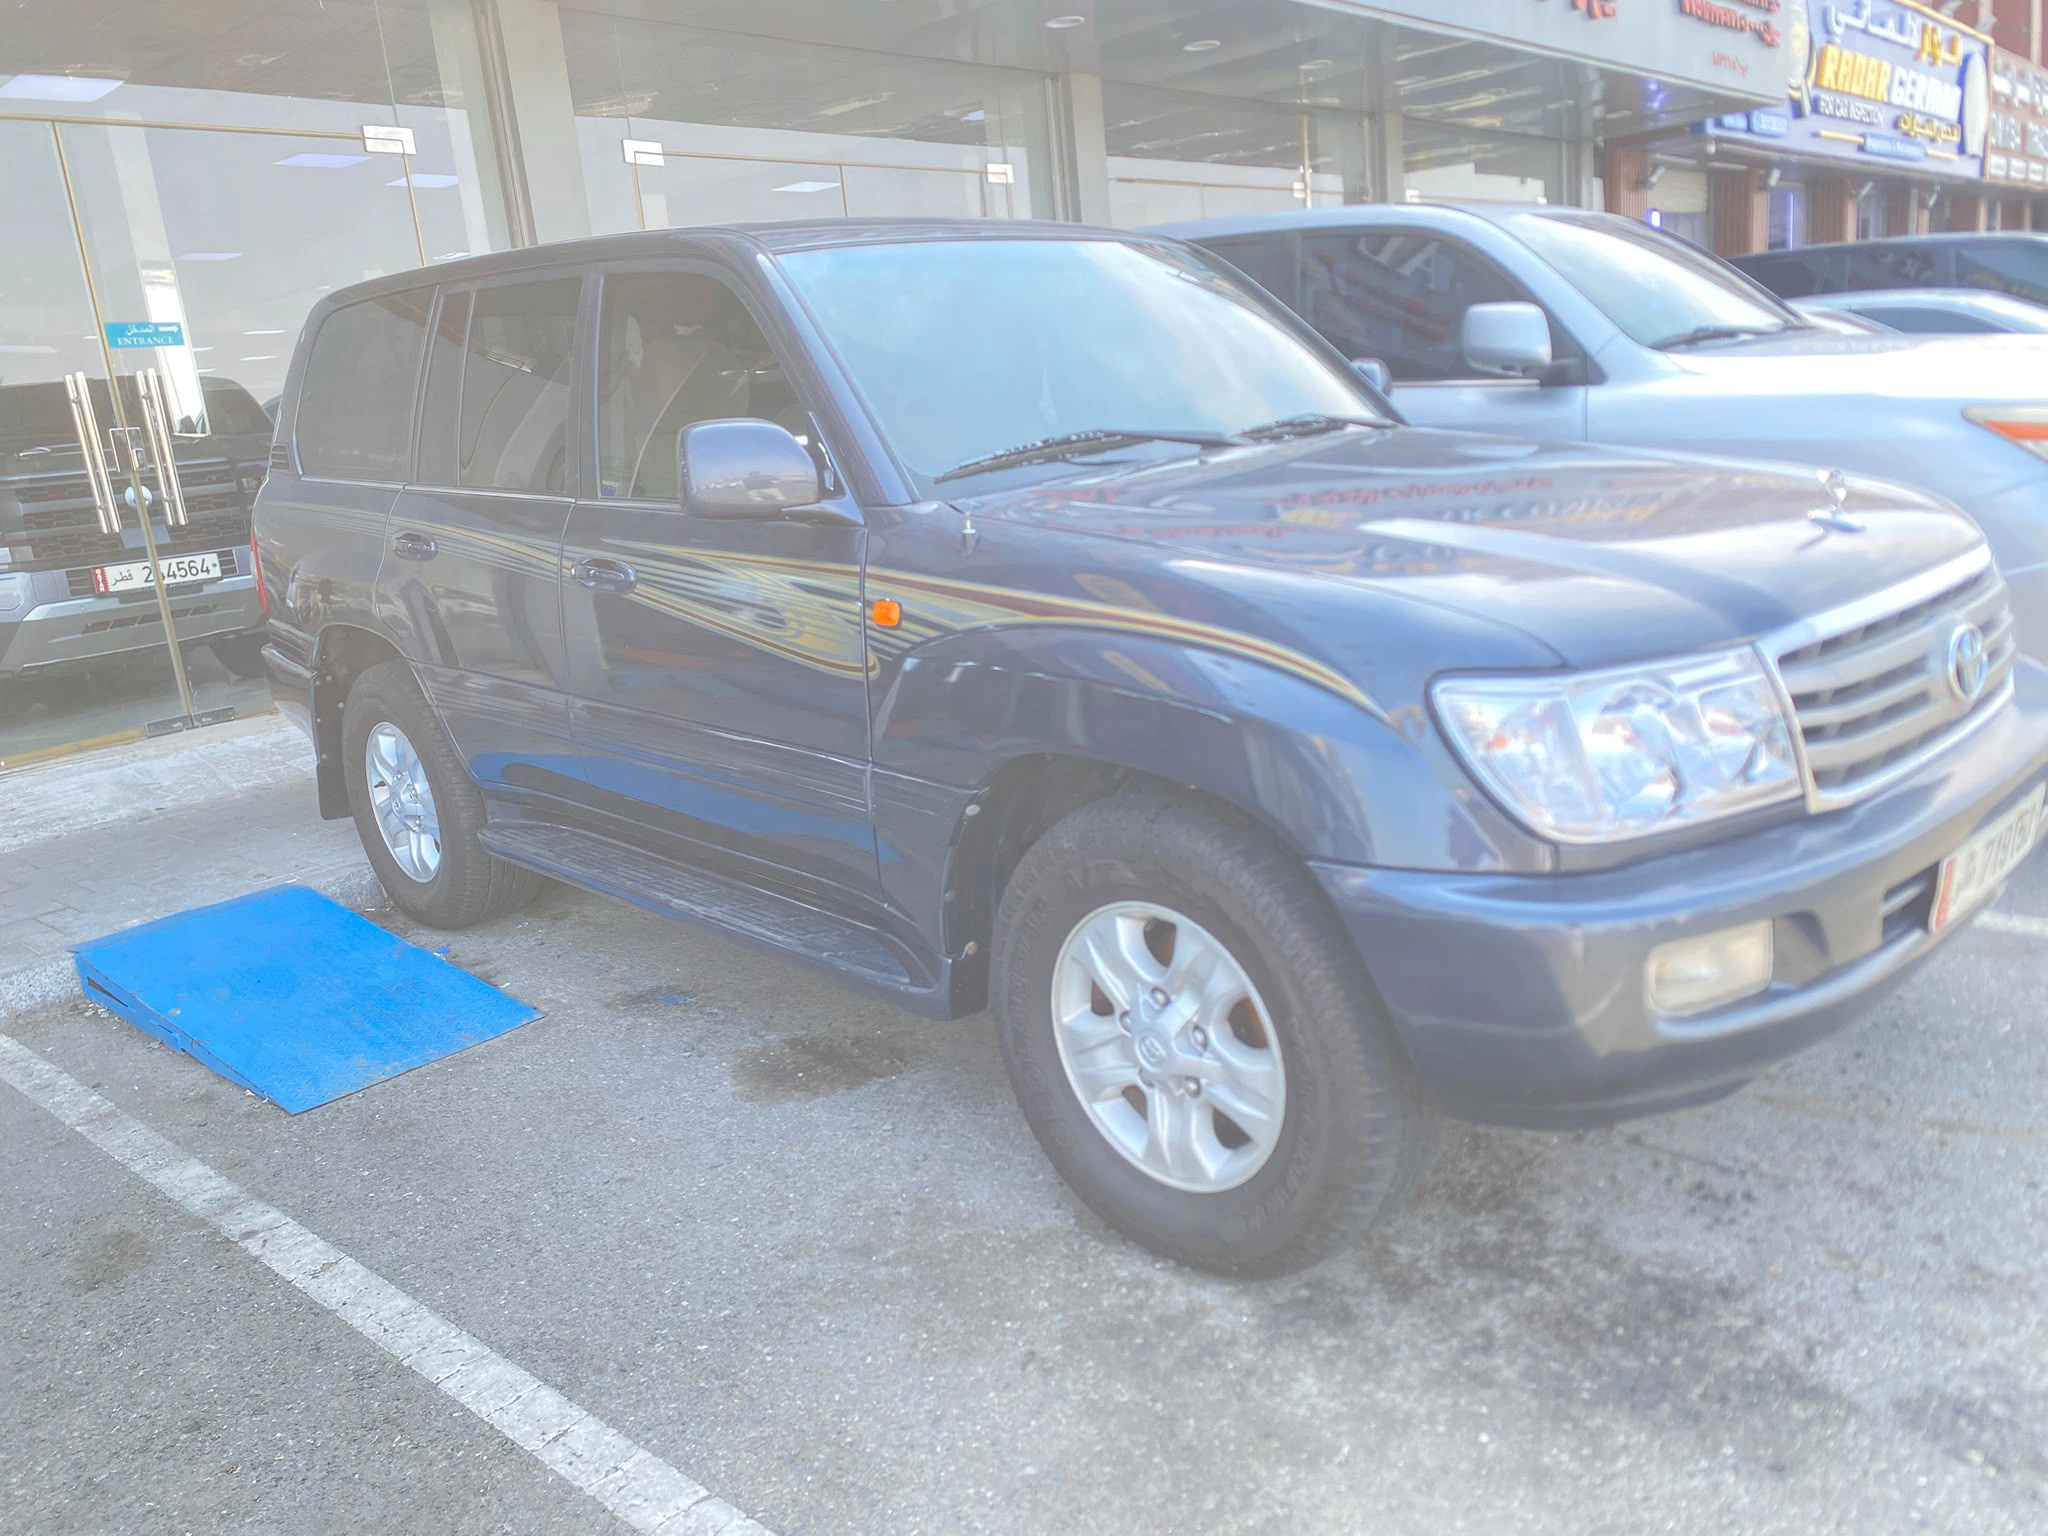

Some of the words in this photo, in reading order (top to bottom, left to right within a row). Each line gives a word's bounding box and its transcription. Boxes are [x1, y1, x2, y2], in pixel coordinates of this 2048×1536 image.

[1818, 44, 1891, 103] RADAR
[1890, 64, 1962, 121] GERMAN
[117, 335, 175, 346] ENTRANCE
[112, 569, 134, 586] قطر
[141, 558, 211, 583] 24564
